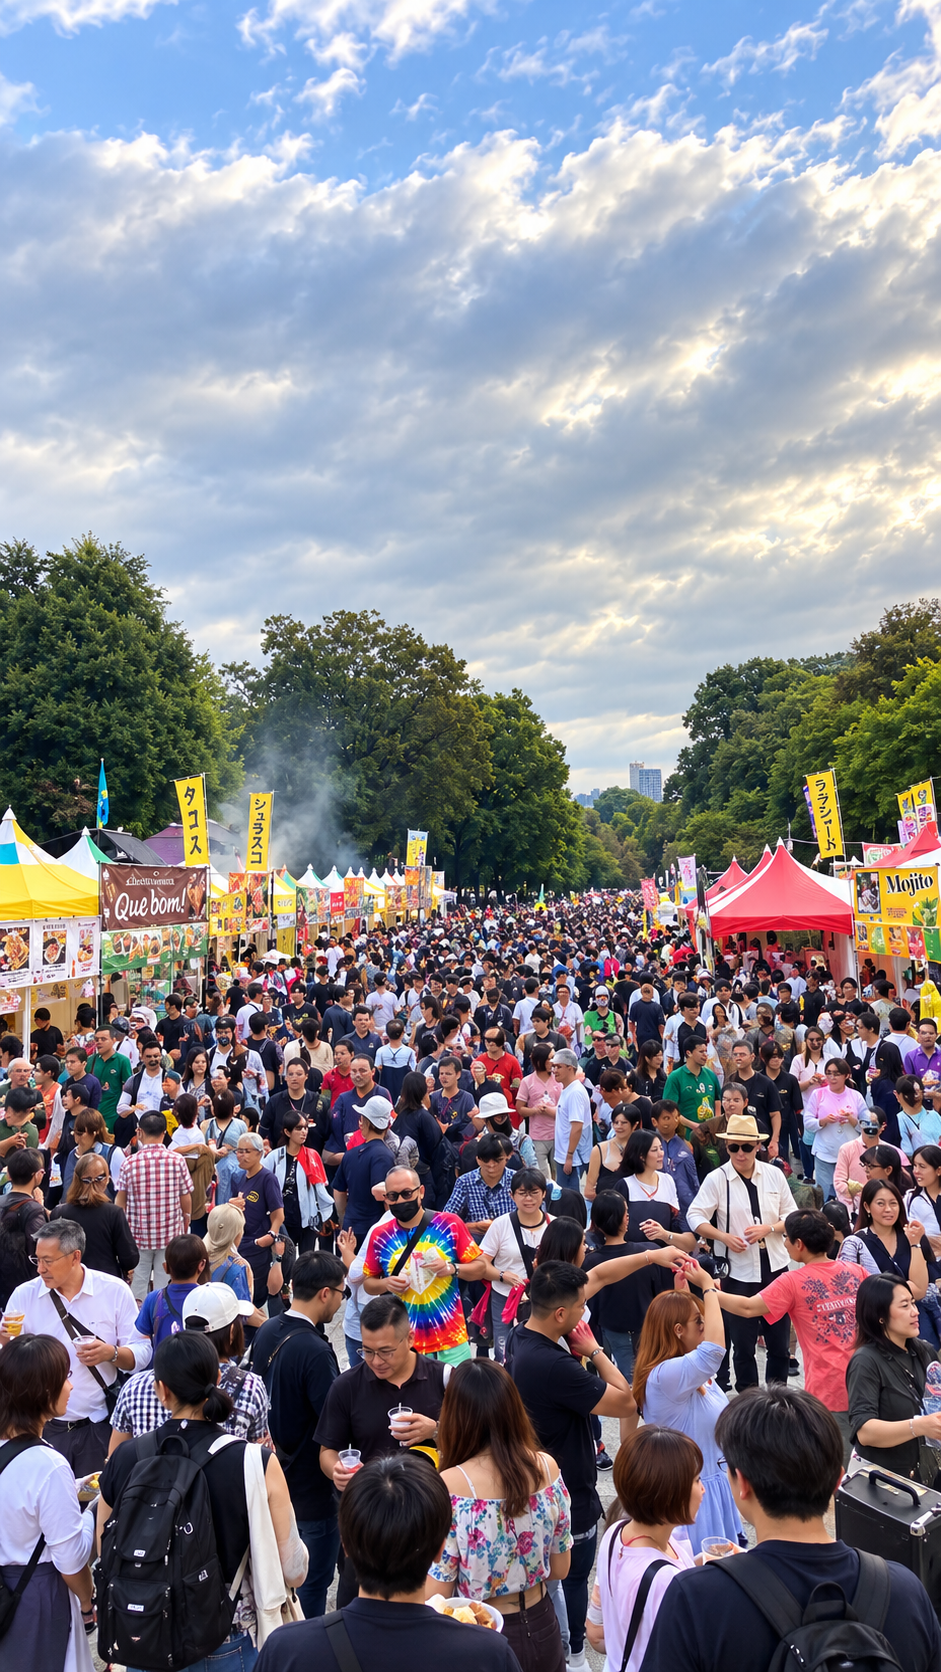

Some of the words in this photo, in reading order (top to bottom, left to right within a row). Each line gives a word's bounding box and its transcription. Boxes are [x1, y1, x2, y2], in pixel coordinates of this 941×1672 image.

[184, 786, 202, 855] タコス
[250, 798, 266, 864] シュラスコ
[114, 892, 148, 921] Que
[150, 887, 186, 916] bom!
[885, 872, 934, 897] Mojito
